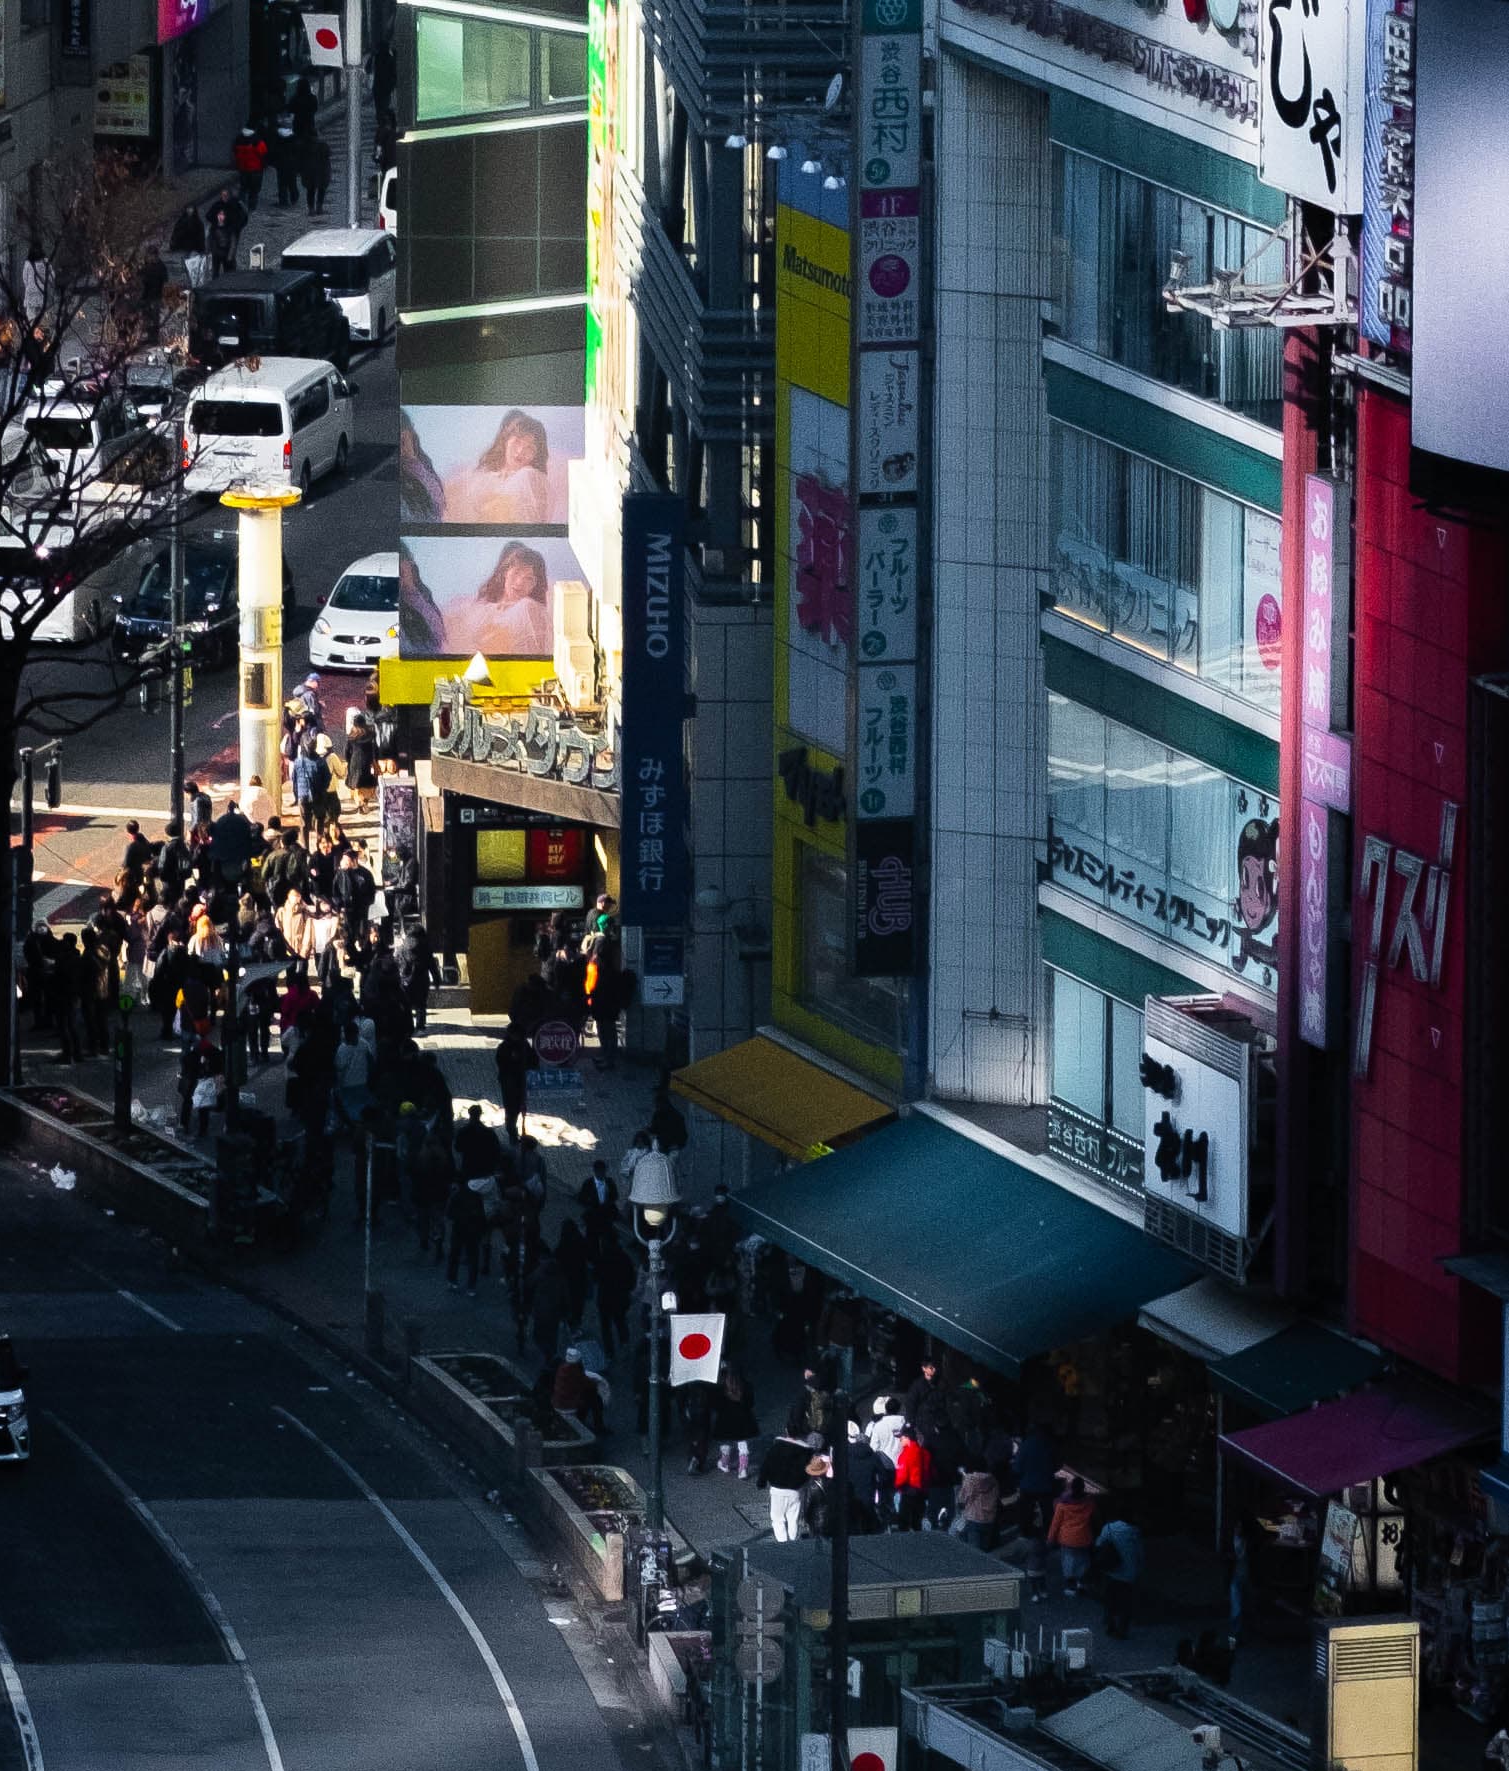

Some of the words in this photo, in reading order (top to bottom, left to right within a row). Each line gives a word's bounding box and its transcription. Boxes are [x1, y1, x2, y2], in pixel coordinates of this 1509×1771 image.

[646, 532, 672, 659] MIZUHO
[866, 551, 885, 626] パーラー
[891, 538, 909, 614] フルーツ
[865, 707, 883, 783] フルーツ
[639, 757, 665, 891] みずほ銀行
[869, 856, 912, 935] HUB
